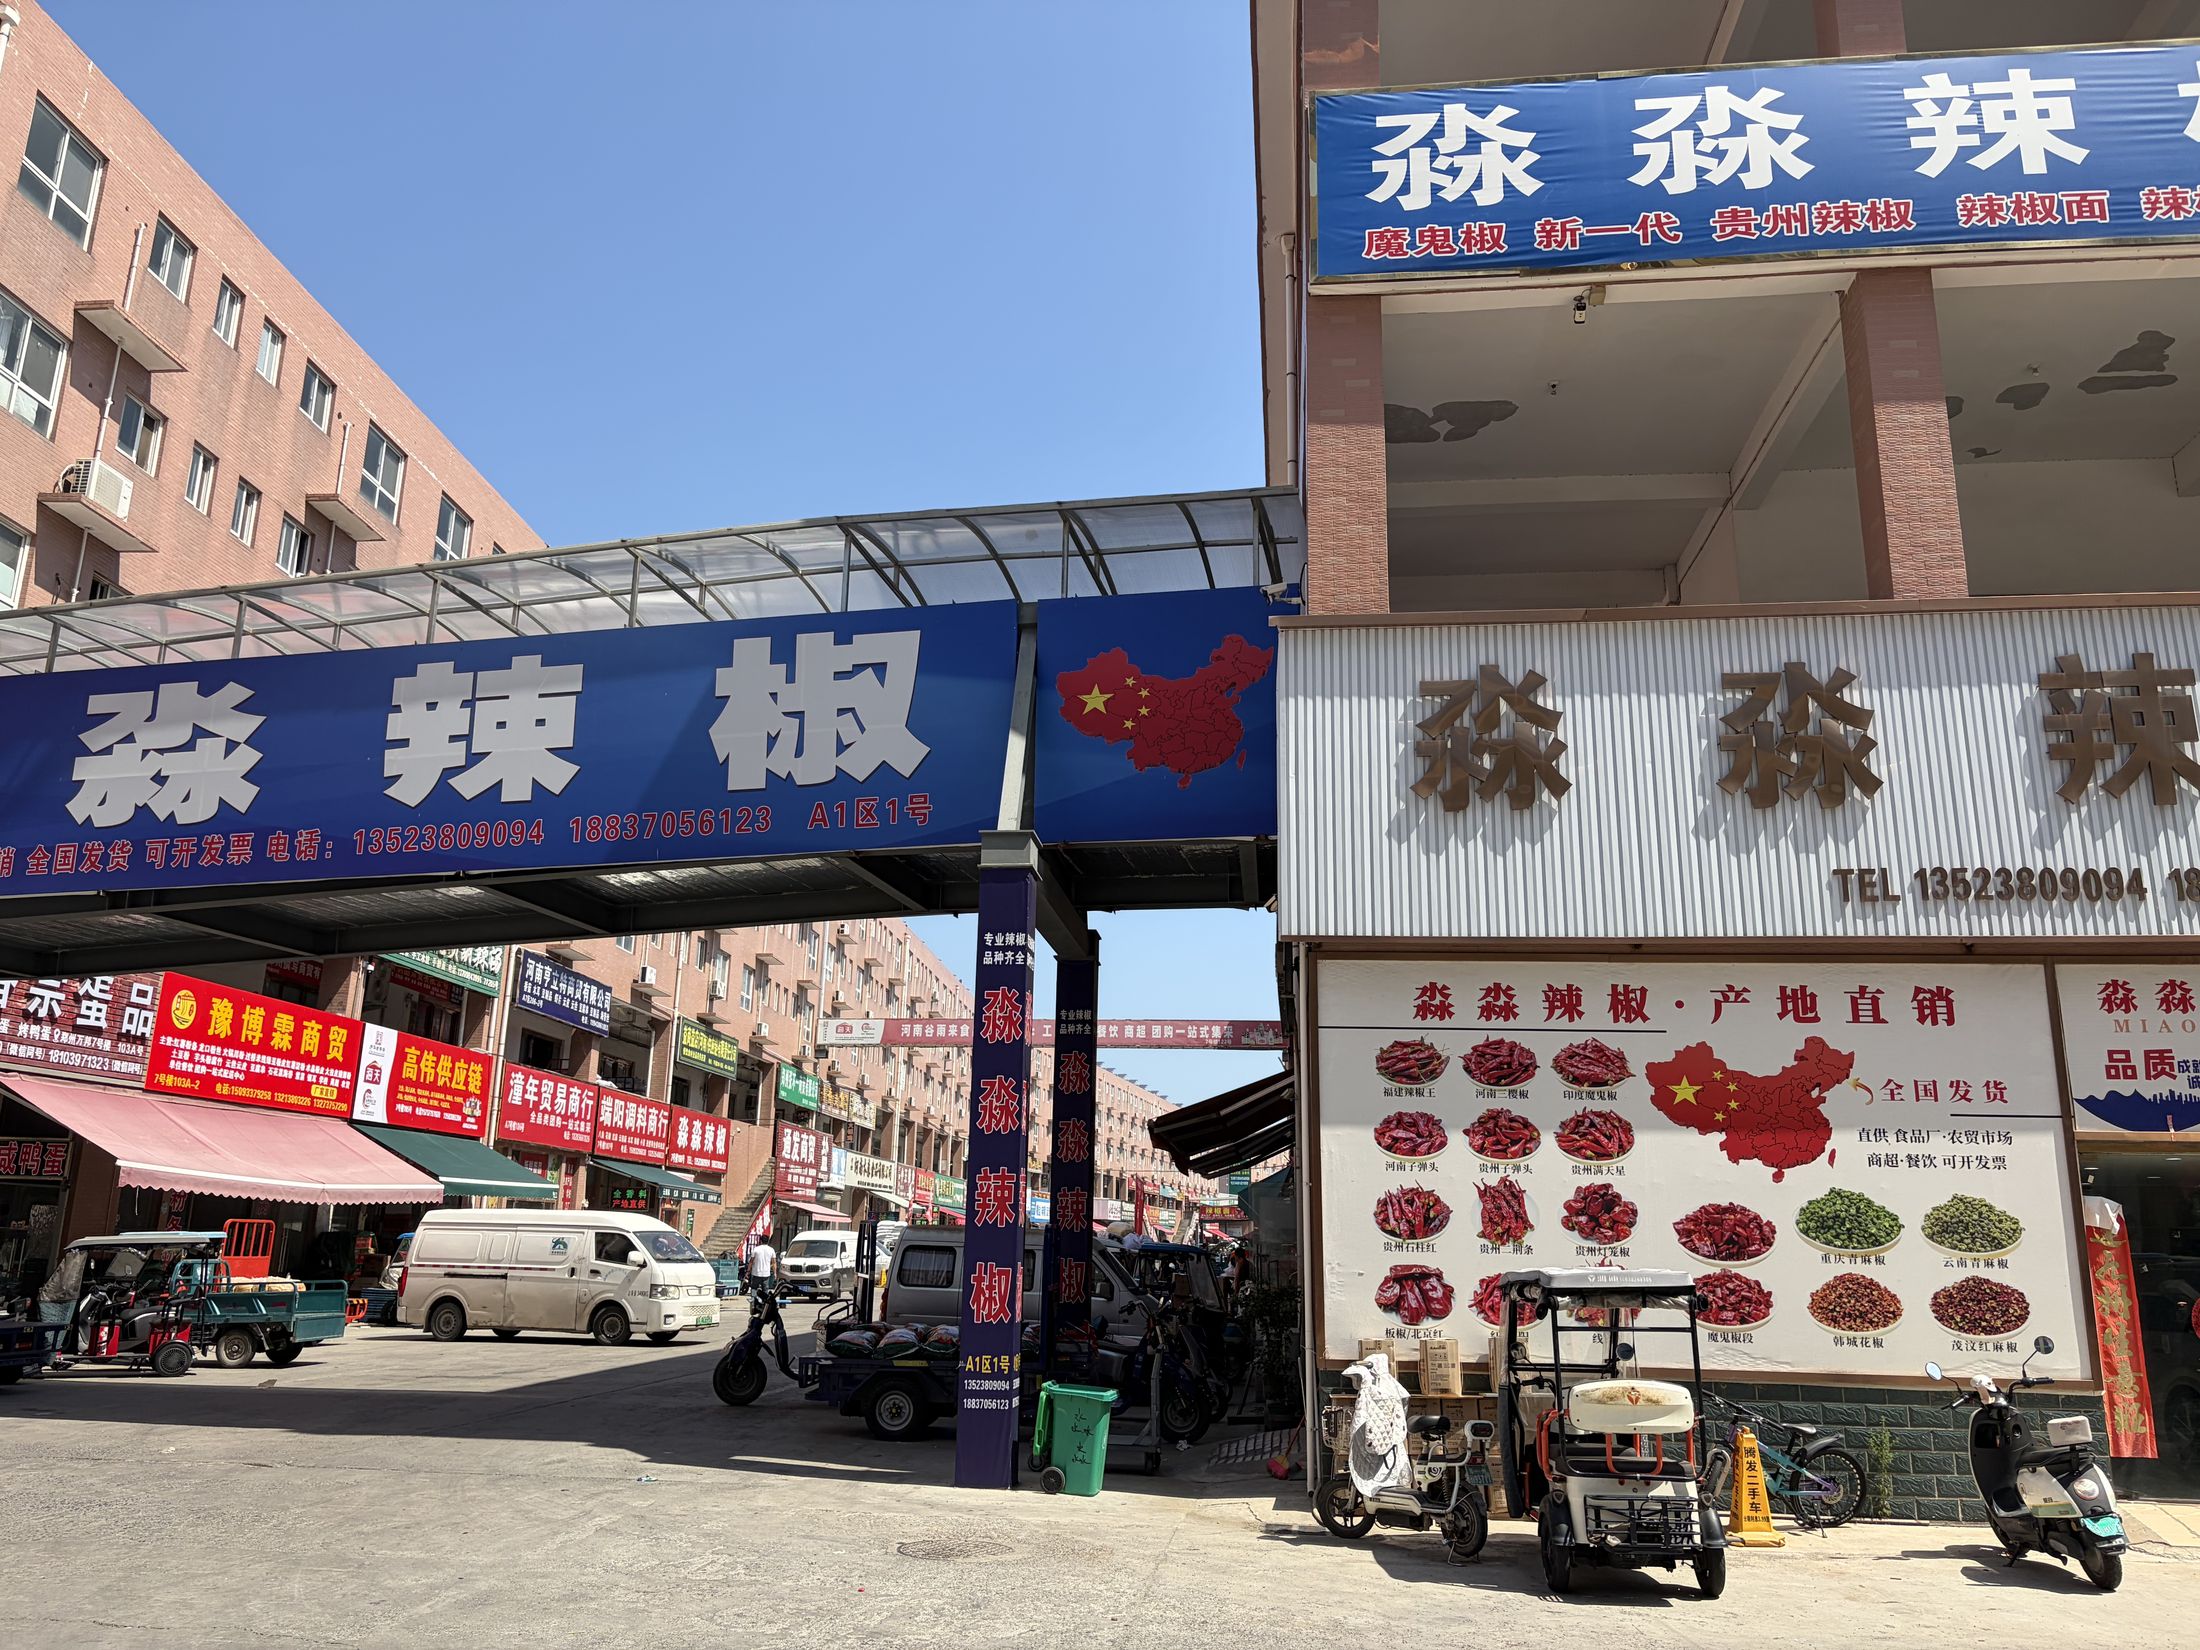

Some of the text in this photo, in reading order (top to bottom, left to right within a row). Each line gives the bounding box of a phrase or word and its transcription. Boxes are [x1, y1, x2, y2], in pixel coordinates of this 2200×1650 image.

[1363, 221, 1508, 259] 魔鬼椒
[1534, 211, 1683, 251] 新一代
[1710, 198, 1916, 241] 贵州辣椒
[1956, 190, 2109, 228] 辣椒面
[65, 629, 931, 828] 淼辣椒
[26, 839, 133, 876] 全国发货
[145, 832, 254, 869] 可开发票
[353, 818, 544, 855] 13523809094
[570, 806, 772, 843] 18837056123
[807, 792, 933, 830] A1区1号
[1832, 867, 1901, 903] TEL
[1913, 866, 2148, 902] 13523809094
[984, 932, 1026, 947] 专业辣椒
[983, 951, 1025, 965] 品种齐全
[1059, 1009, 1092, 1021] 专业辣椒
[17, 1022, 52, 1042] 烤鸭蛋
[207, 997, 348, 1063] 豫博霖商贸
[1059, 1023, 1091, 1035] 品种齐全
[1124, 1024, 1147, 1038] 商超
[1151, 1024, 1233, 1039] 团购一站式集采
[402, 1046, 483, 1094] 高伟供应链
[508, 1072, 594, 1120] 潼年贸易商行
[1383, 1087, 1618, 1101] 福建辣椒王 河南三樱椒 印度魔鬼椒
[1880, 1078, 2009, 1104] 全国发货
[600, 1095, 669, 1139] 端阳调料商行
[1857, 1127, 1889, 1144] 直供
[970, 986, 1023, 1324] 淼淼辣椒
[1942, 1154, 2007, 1170] 可开发票
[1385, 1160, 1626, 1176] 河南子弹头 贵州子弹头 贵州满天星
[1383, 1241, 1631, 1258] 贵州石柱红 贵州二荆条 贵州灯笼椒
[1820, 1253, 2010, 1270] 重庆青麻椒 云南青麻椒
[1385, 1327, 1443, 1340] 板椒/北京红
[1707, 1332, 1754, 1345] 魔鬼椒段
[1832, 1336, 1884, 1349] 韩城花椒
[965, 1355, 1010, 1374] A1区1号
[964, 1380, 1010, 1391] 13523809094
[963, 1399, 1009, 1410] 18837056123
[1744, 1446, 1763, 1513] 腾发二手车
